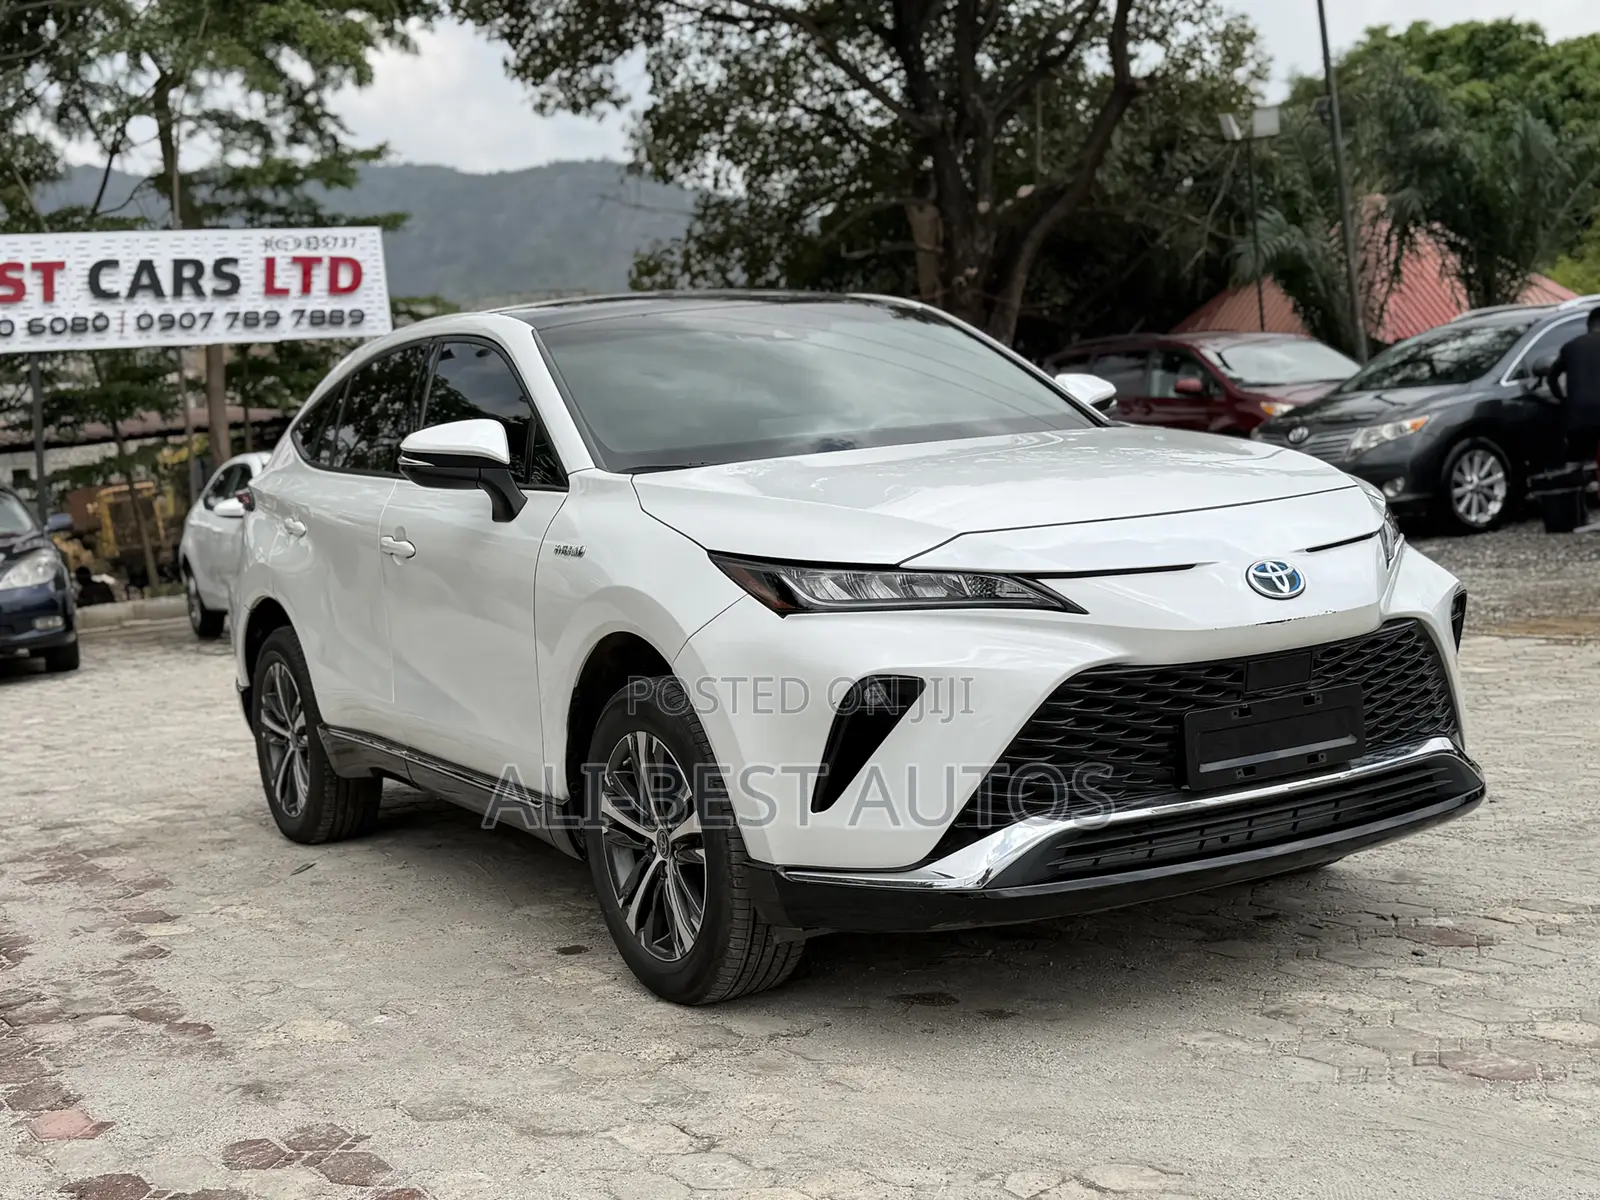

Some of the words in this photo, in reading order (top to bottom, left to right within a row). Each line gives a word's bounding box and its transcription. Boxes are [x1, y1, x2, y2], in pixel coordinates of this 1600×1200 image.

[88, 257, 241, 299] CARS
[264, 256, 363, 296] LTD
[27, 313, 109, 335] 6080
[136, 312, 214, 331] 0907
[225, 310, 281, 330] 789
[291, 309, 365, 328] 7889
